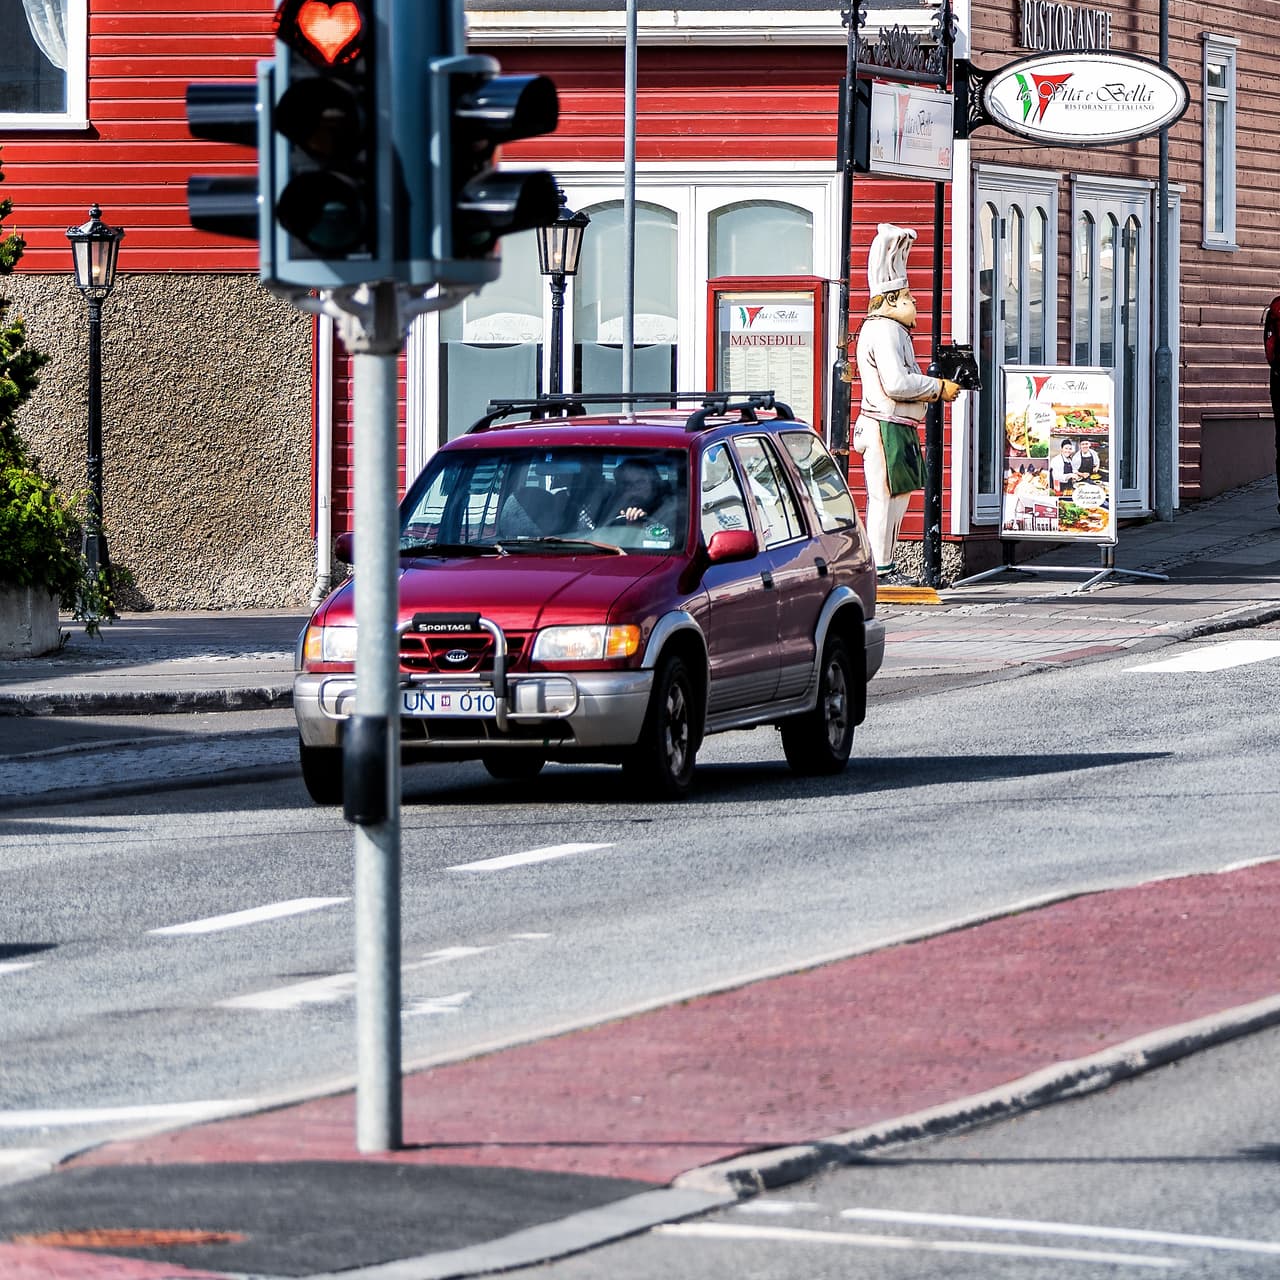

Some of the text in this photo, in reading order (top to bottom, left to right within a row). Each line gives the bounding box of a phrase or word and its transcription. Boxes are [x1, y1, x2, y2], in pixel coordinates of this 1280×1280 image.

[1096, 81, 1155, 102] Bella
[403, 692, 435, 712] UN
[459, 694, 495, 712] 010
